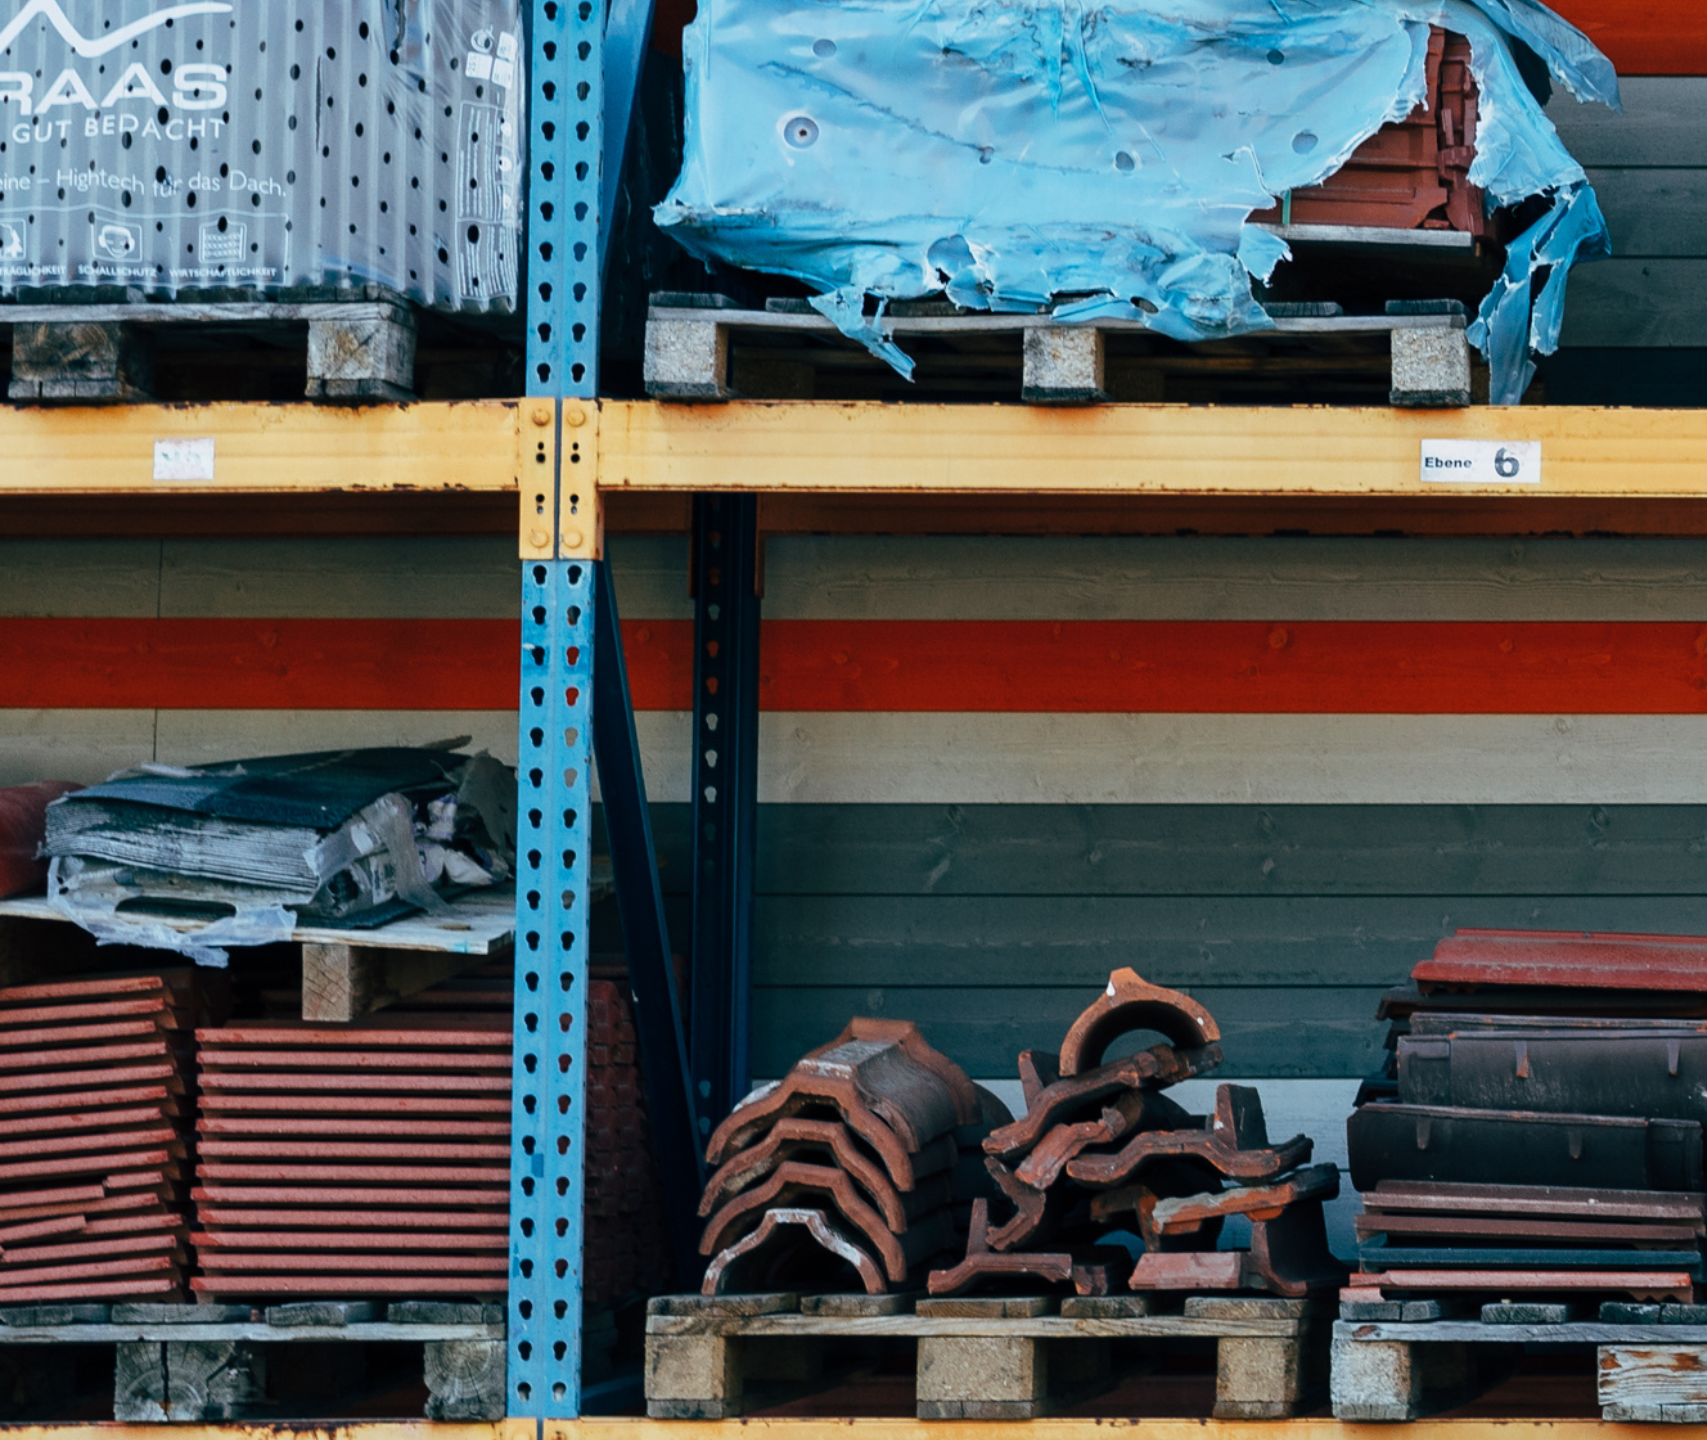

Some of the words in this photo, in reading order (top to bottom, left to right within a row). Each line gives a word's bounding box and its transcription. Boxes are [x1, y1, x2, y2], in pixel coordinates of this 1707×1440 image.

[12, 119, 72, 144] GUT
[84, 113, 226, 141] BEDACHT
[57, 167, 145, 196] Hightech
[188, 170, 221, 192] das
[230, 168, 287, 198] Dach.
[78, 263, 158, 278] SCHALLSCHUTZ
[1424, 456, 1473, 469] Ebene
[1494, 447, 1520, 478] 6
